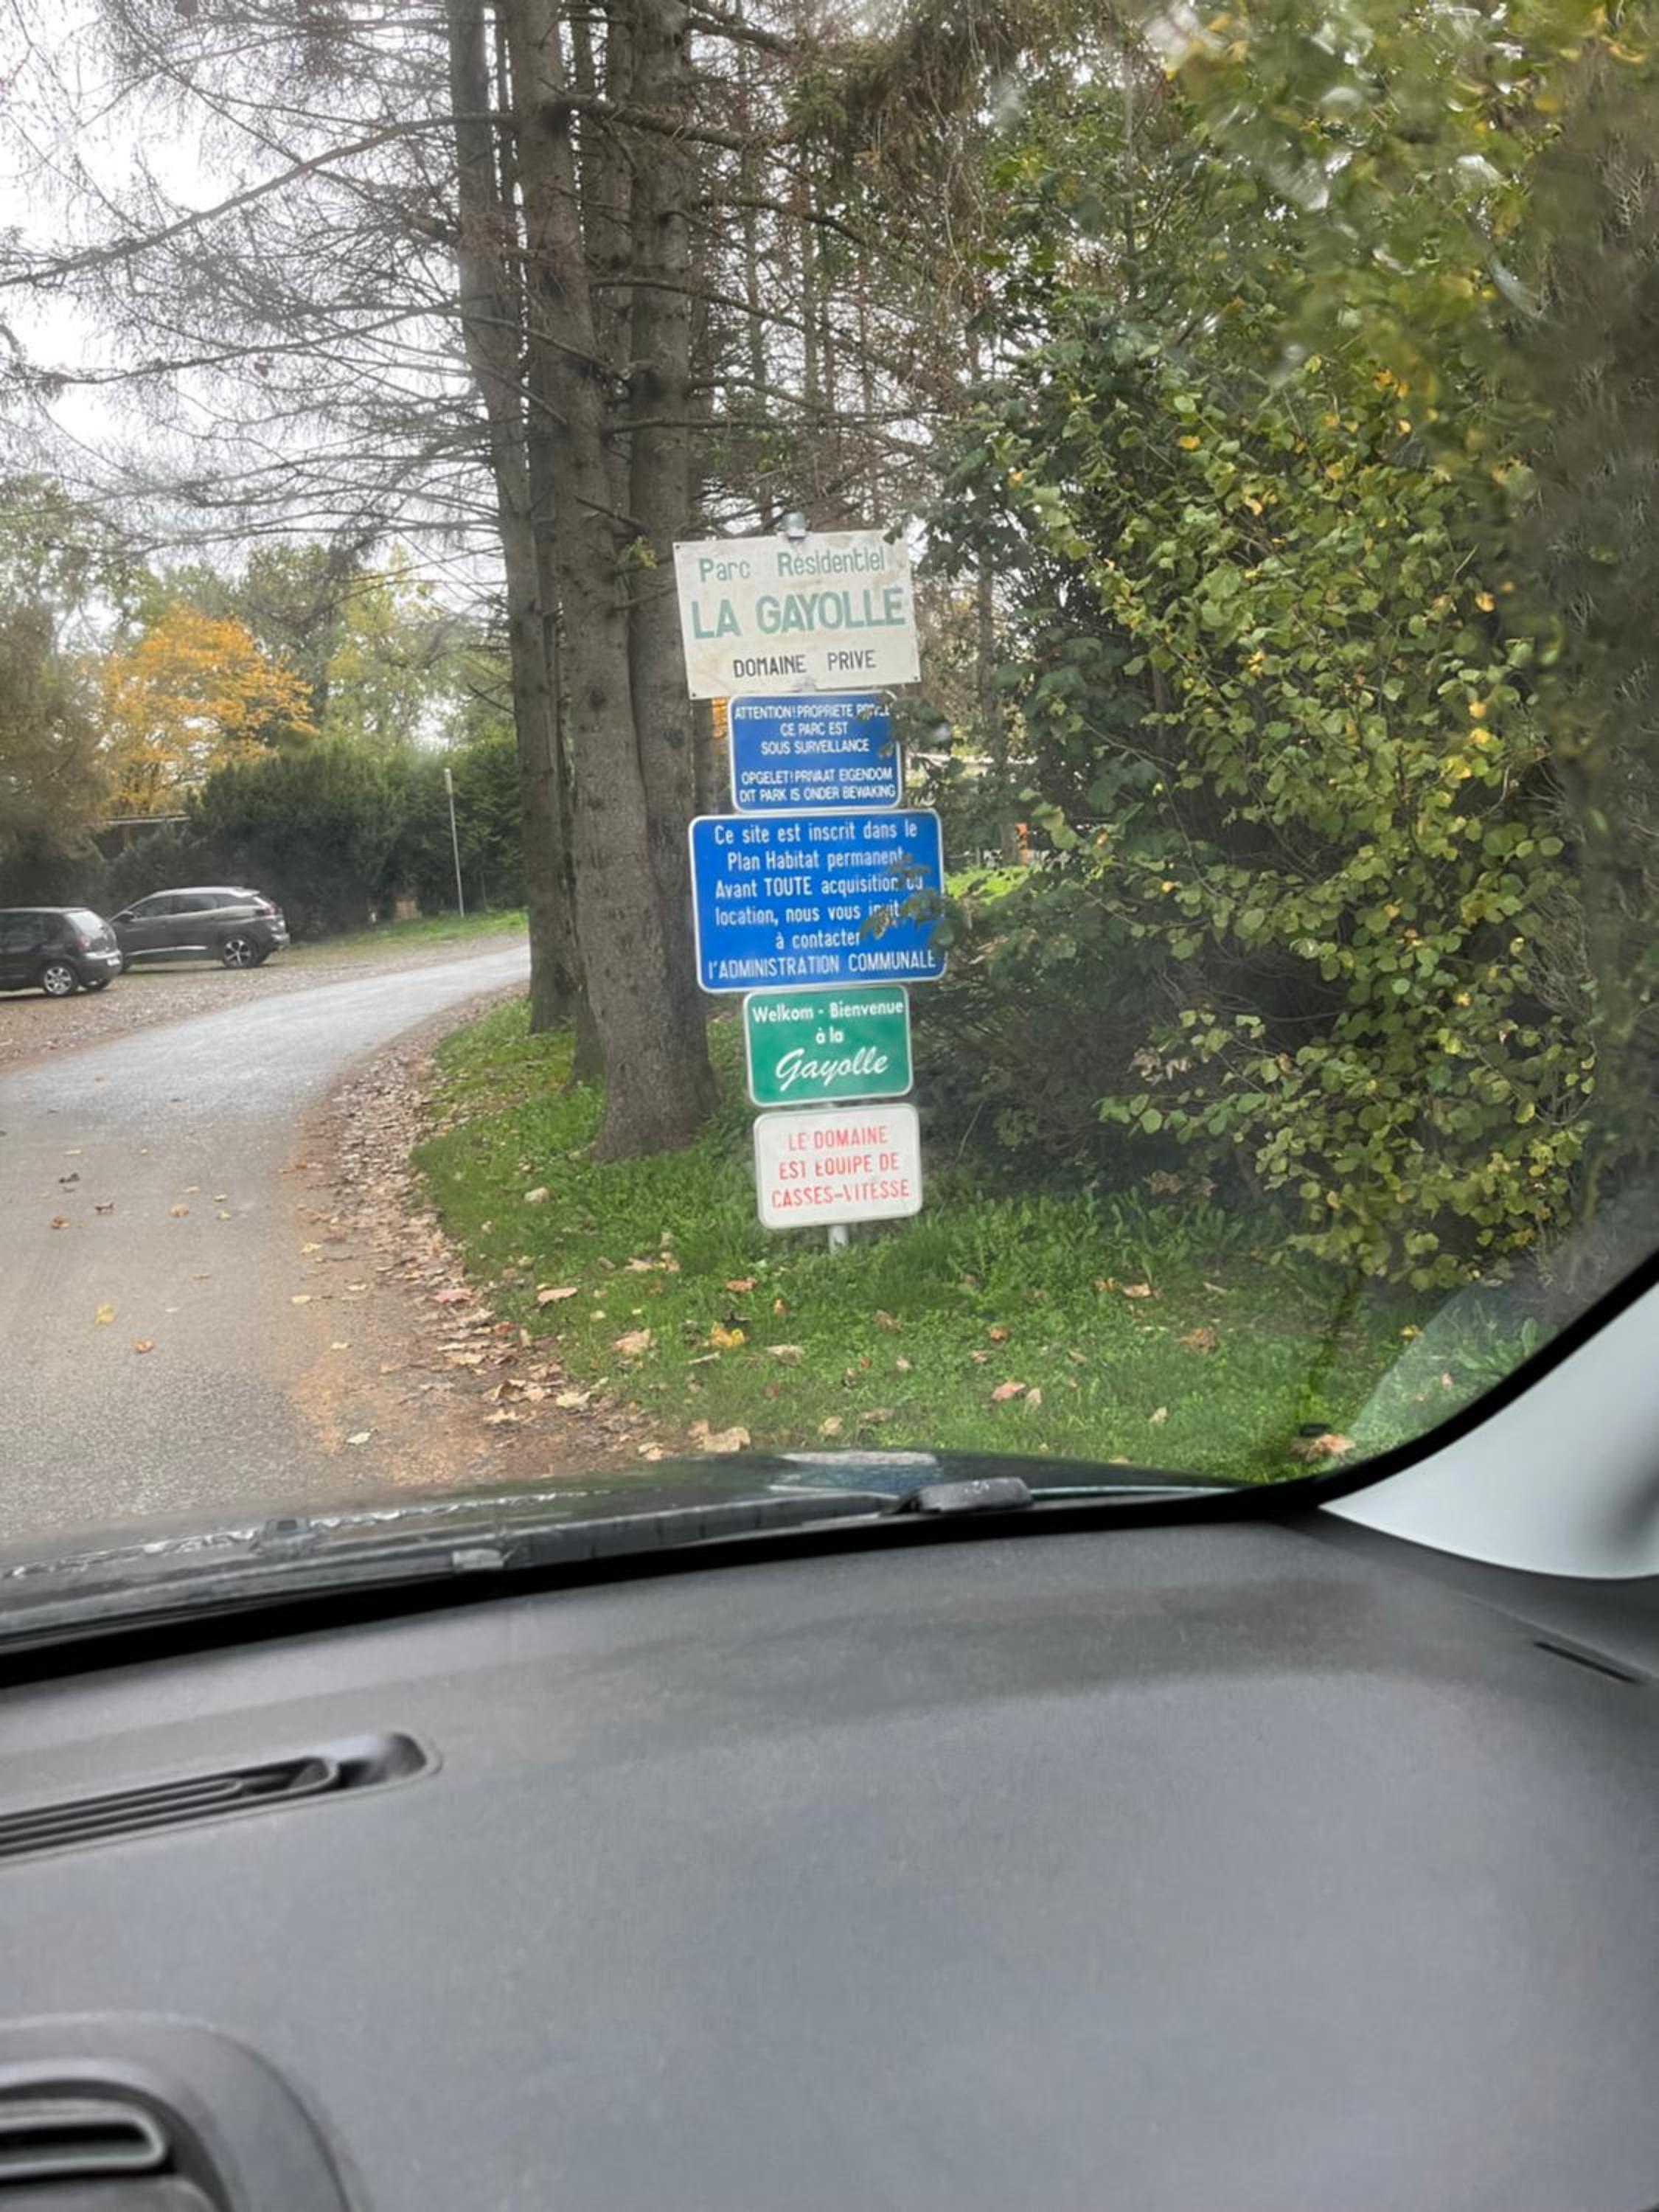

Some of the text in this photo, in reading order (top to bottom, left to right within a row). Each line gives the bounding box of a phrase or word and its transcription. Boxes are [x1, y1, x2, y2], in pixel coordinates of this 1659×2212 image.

[699, 557, 751, 582] Parc
[691, 588, 905, 639] LA GAYOLLE
[734, 650, 877, 678] DOMAINE PRIVE
[780, 721, 848, 737] CE PARC EST
[760, 738, 870, 755] SOUS SURVEILLANCE
[839, 767, 892, 782] EIGENDOM
[740, 785, 895, 803] DIT PARK IS ONDER BEWAKING
[714, 818, 917, 845] Ce site est inscrit dans le
[728, 846, 903, 872] Plan Habitat permanent
[715, 880, 757, 900] Avant
[764, 876, 812, 897] TOUTE
[821, 874, 899, 898] acquisition
[715, 907, 779, 927] location,
[786, 903, 820, 922] nous
[828, 902, 860, 921] vous
[776, 929, 860, 950] à contacter
[709, 948, 936, 980] l'ADMINISTRATION COMMUNALE
[753, 1003, 814, 1023] Welkom
[830, 1000, 904, 1018] Bienvenue
[815, 1026, 844, 1044] à la
[775, 1046, 888, 1092] Gayolle
[789, 1126, 887, 1151] LE DOMAINE
[779, 1160, 807, 1180] EST
[879, 1152, 900, 1171] DE
[771, 1179, 909, 1208] CASSES-VITESSE
